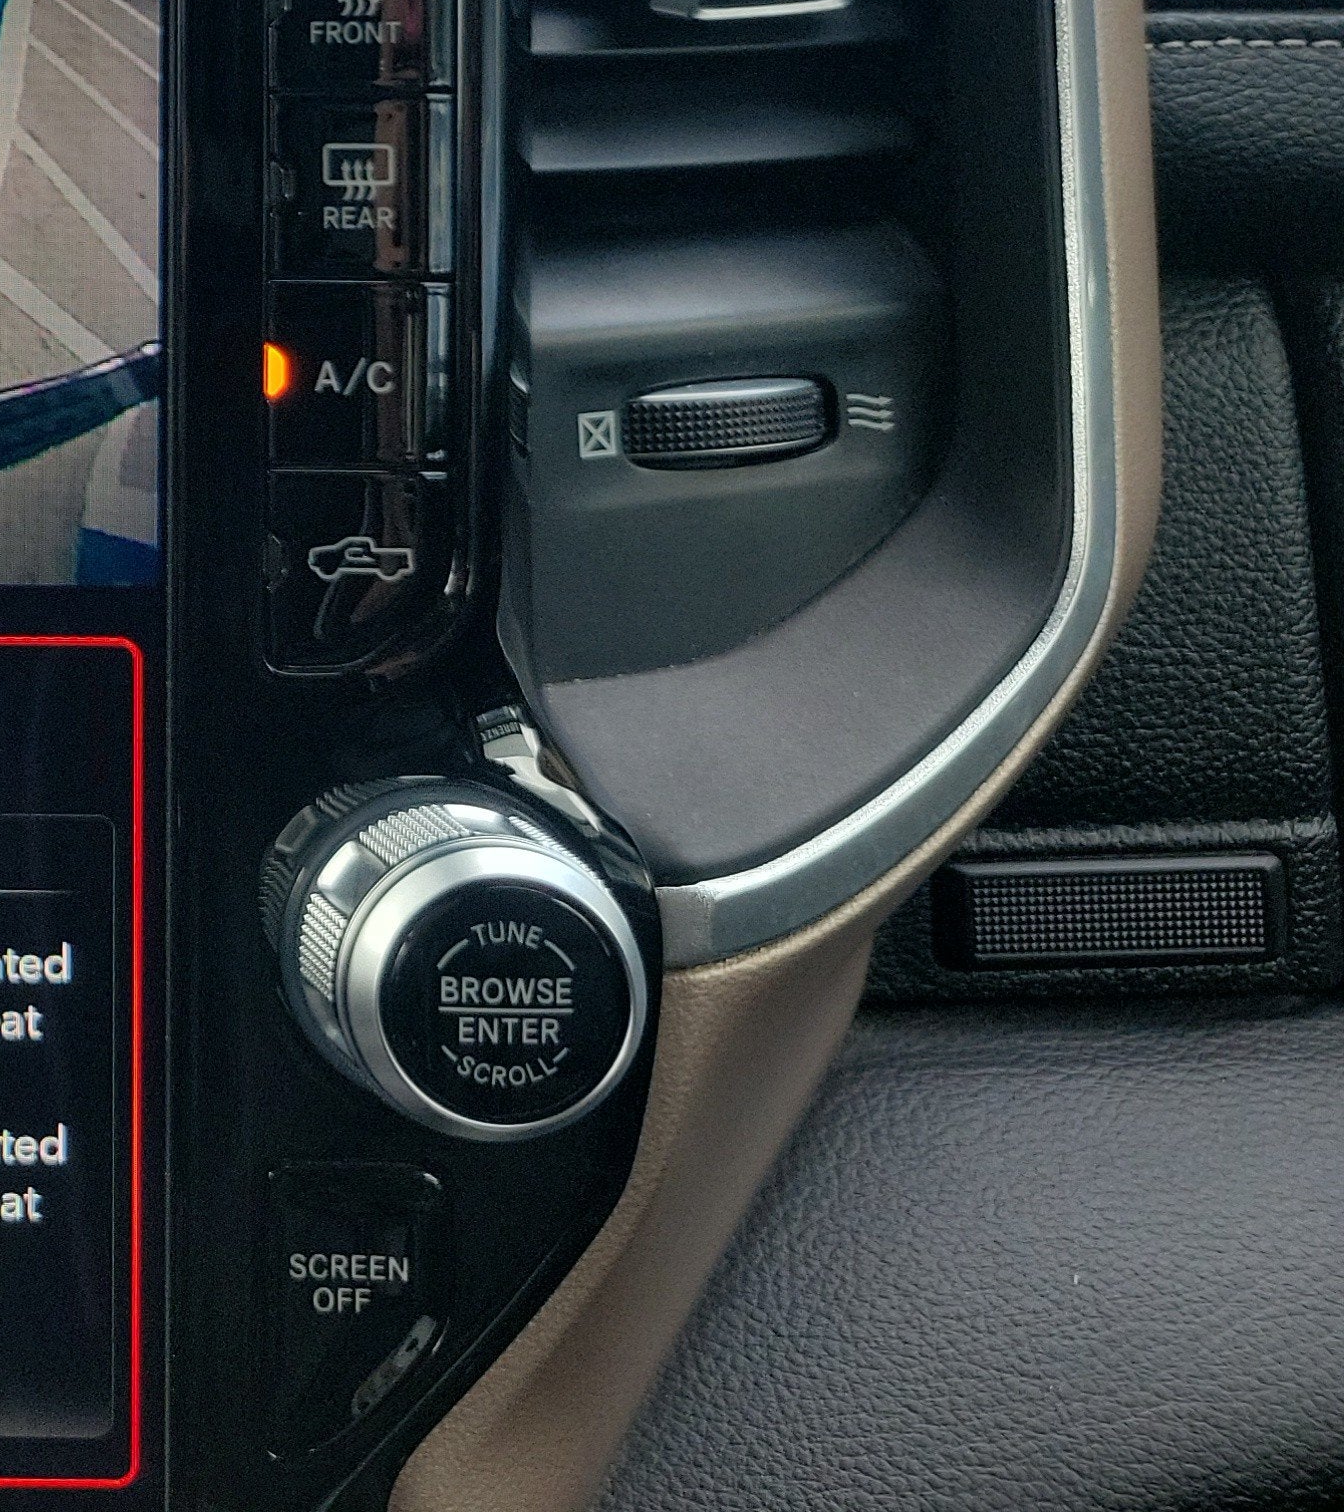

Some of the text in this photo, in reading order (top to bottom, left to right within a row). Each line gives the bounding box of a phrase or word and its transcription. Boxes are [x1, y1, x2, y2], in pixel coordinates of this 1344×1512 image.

[309, 20, 402, 46] FRONT
[321, 205, 394, 231] REAR
[314, 357, 395, 395] A/C
[470, 920, 543, 949] TUNE
[440, 975, 573, 1004] BROWSE
[459, 1016, 560, 1043] ENTER
[457, 1055, 558, 1088] SCROLL
[289, 1252, 409, 1282] SCREEN
[312, 1287, 372, 1314] OFF
